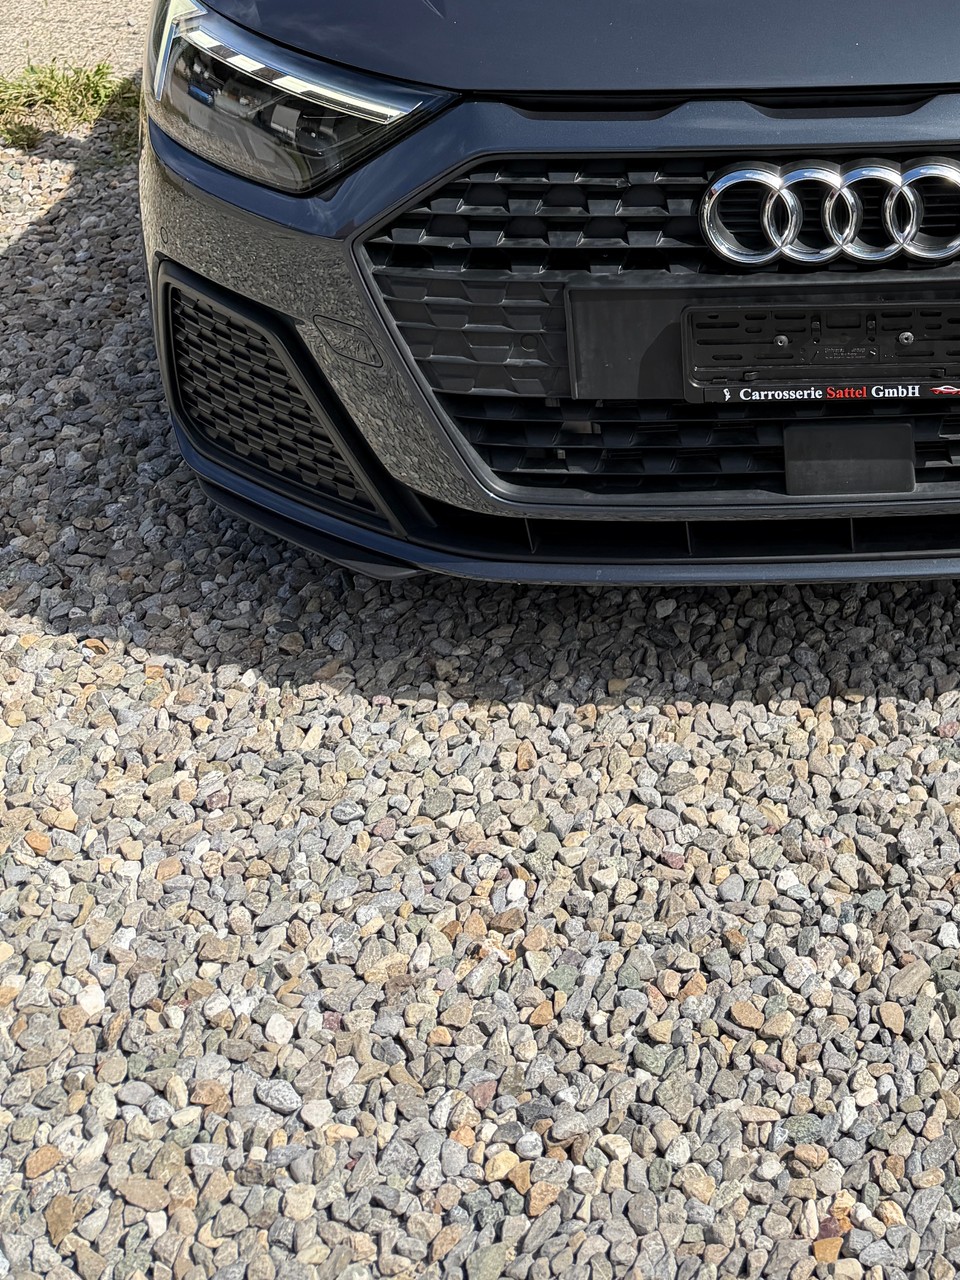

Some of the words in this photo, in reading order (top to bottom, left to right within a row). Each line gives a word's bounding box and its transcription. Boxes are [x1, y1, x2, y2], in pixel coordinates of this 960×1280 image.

[739, 387, 823, 401] Carrosserie
[826, 386, 868, 399] Sattel
[871, 385, 920, 398] GmbH
